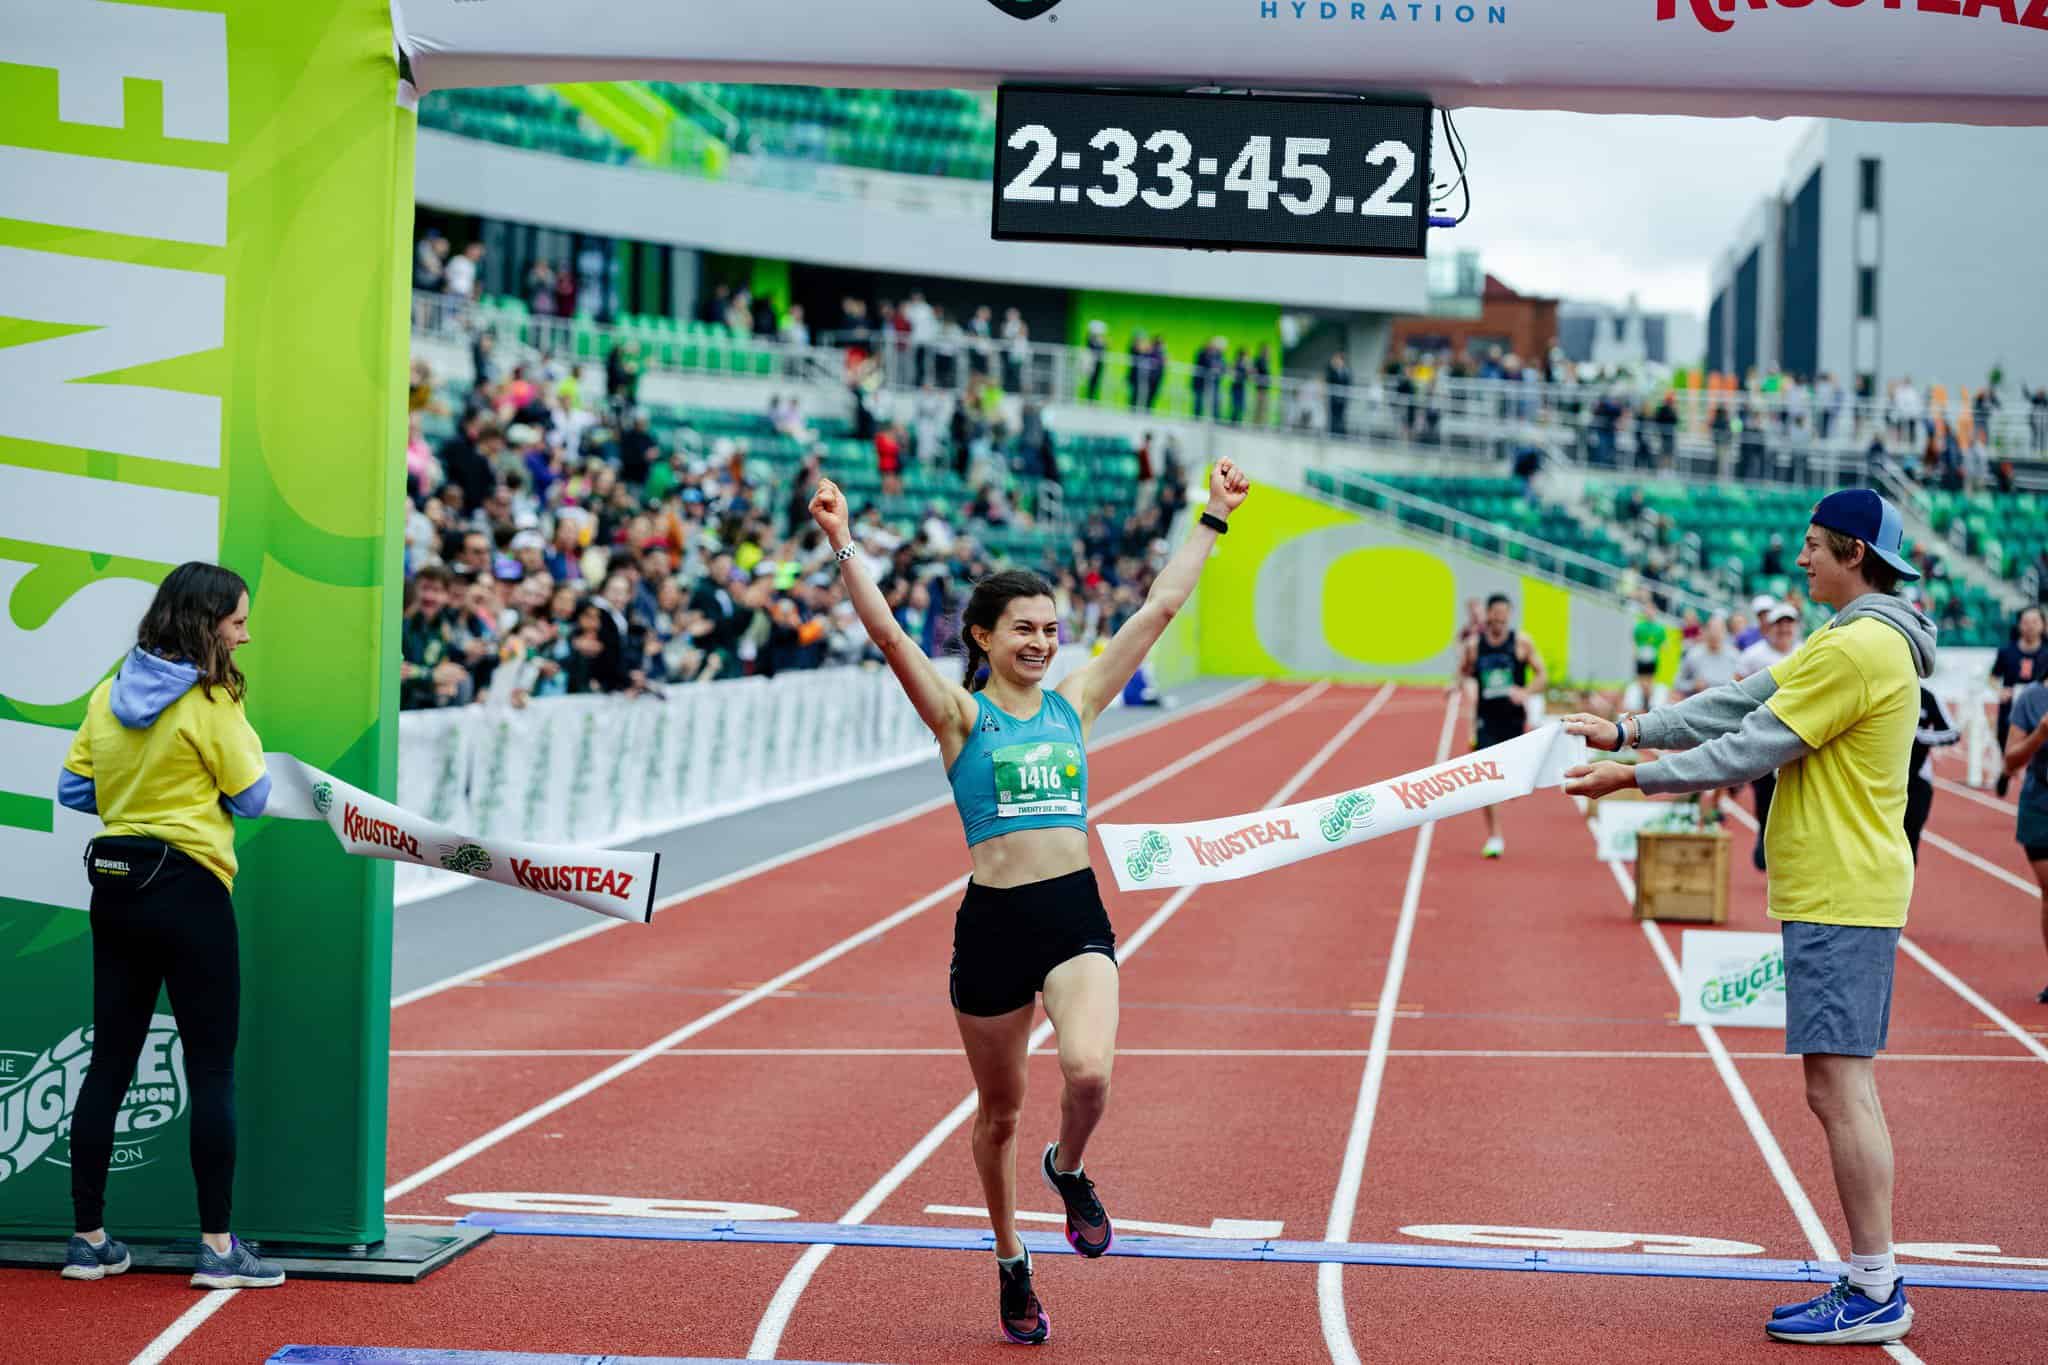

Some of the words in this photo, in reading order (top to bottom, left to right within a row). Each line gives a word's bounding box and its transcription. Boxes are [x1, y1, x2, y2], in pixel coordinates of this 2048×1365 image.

[1260, 1, 1506, 25] HYDRATION
[1003, 124, 1416, 217] 2:33:45.2
[1018, 765, 1061, 790] 1416
[1388, 760, 1504, 810] KRUSTEAZ
[343, 801, 424, 860] KRUSTEAZ
[1185, 818, 1299, 868] KRUSTEAZ
[510, 857, 634, 900] KRUSTEAZ
